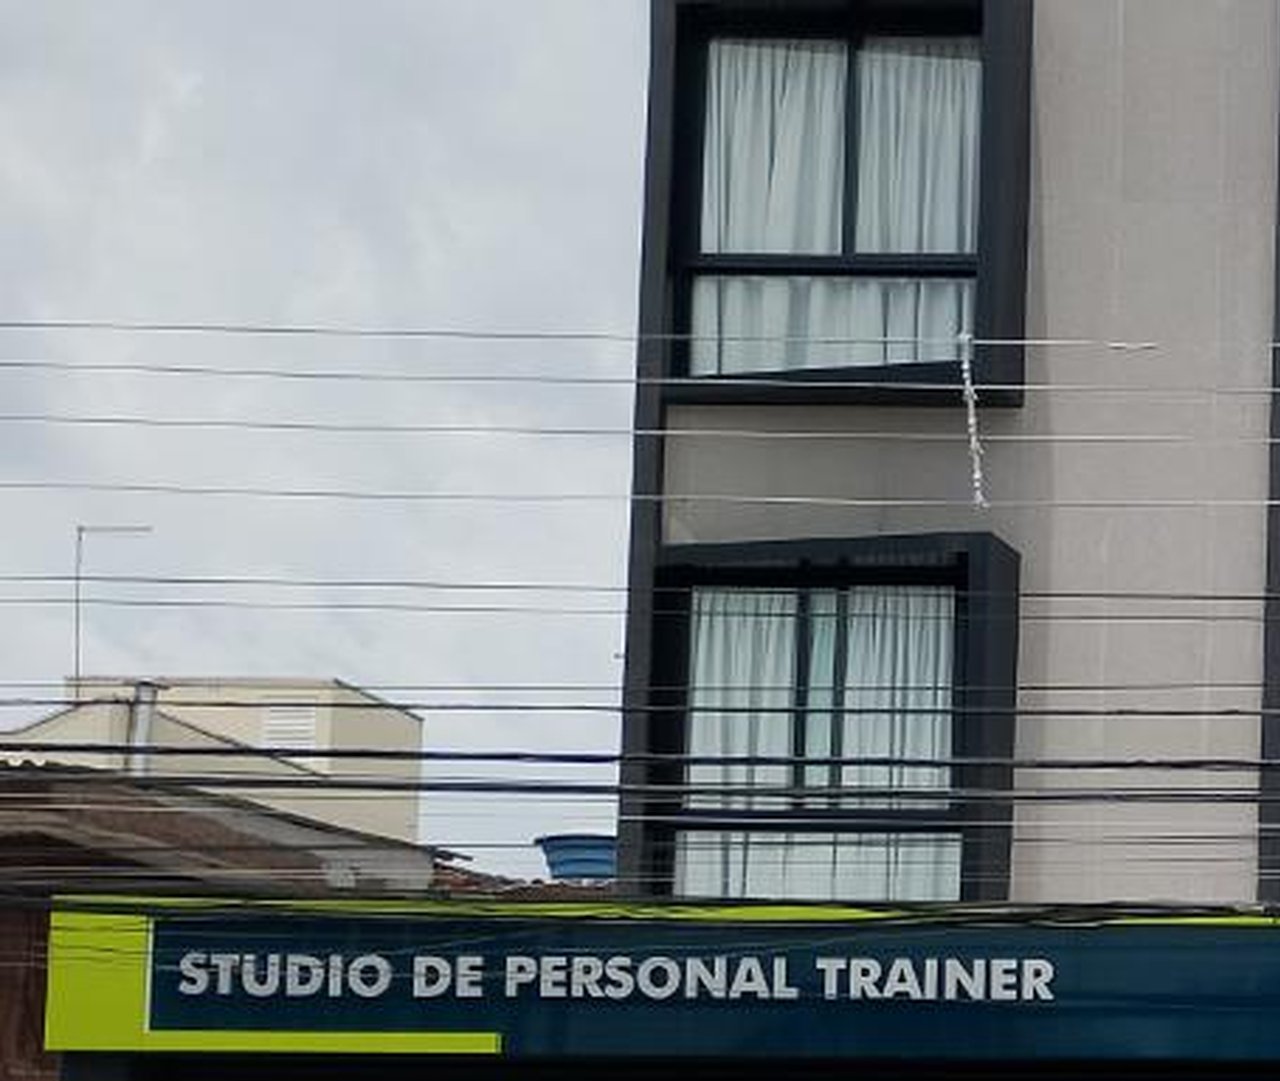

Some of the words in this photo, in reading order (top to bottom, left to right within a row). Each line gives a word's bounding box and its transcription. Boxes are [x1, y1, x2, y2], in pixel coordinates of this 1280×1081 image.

[177, 952, 394, 998] STUDIO
[413, 956, 484, 999] DE
[505, 956, 799, 1000] PERSONAL
[816, 957, 1055, 1001] TRAINER
